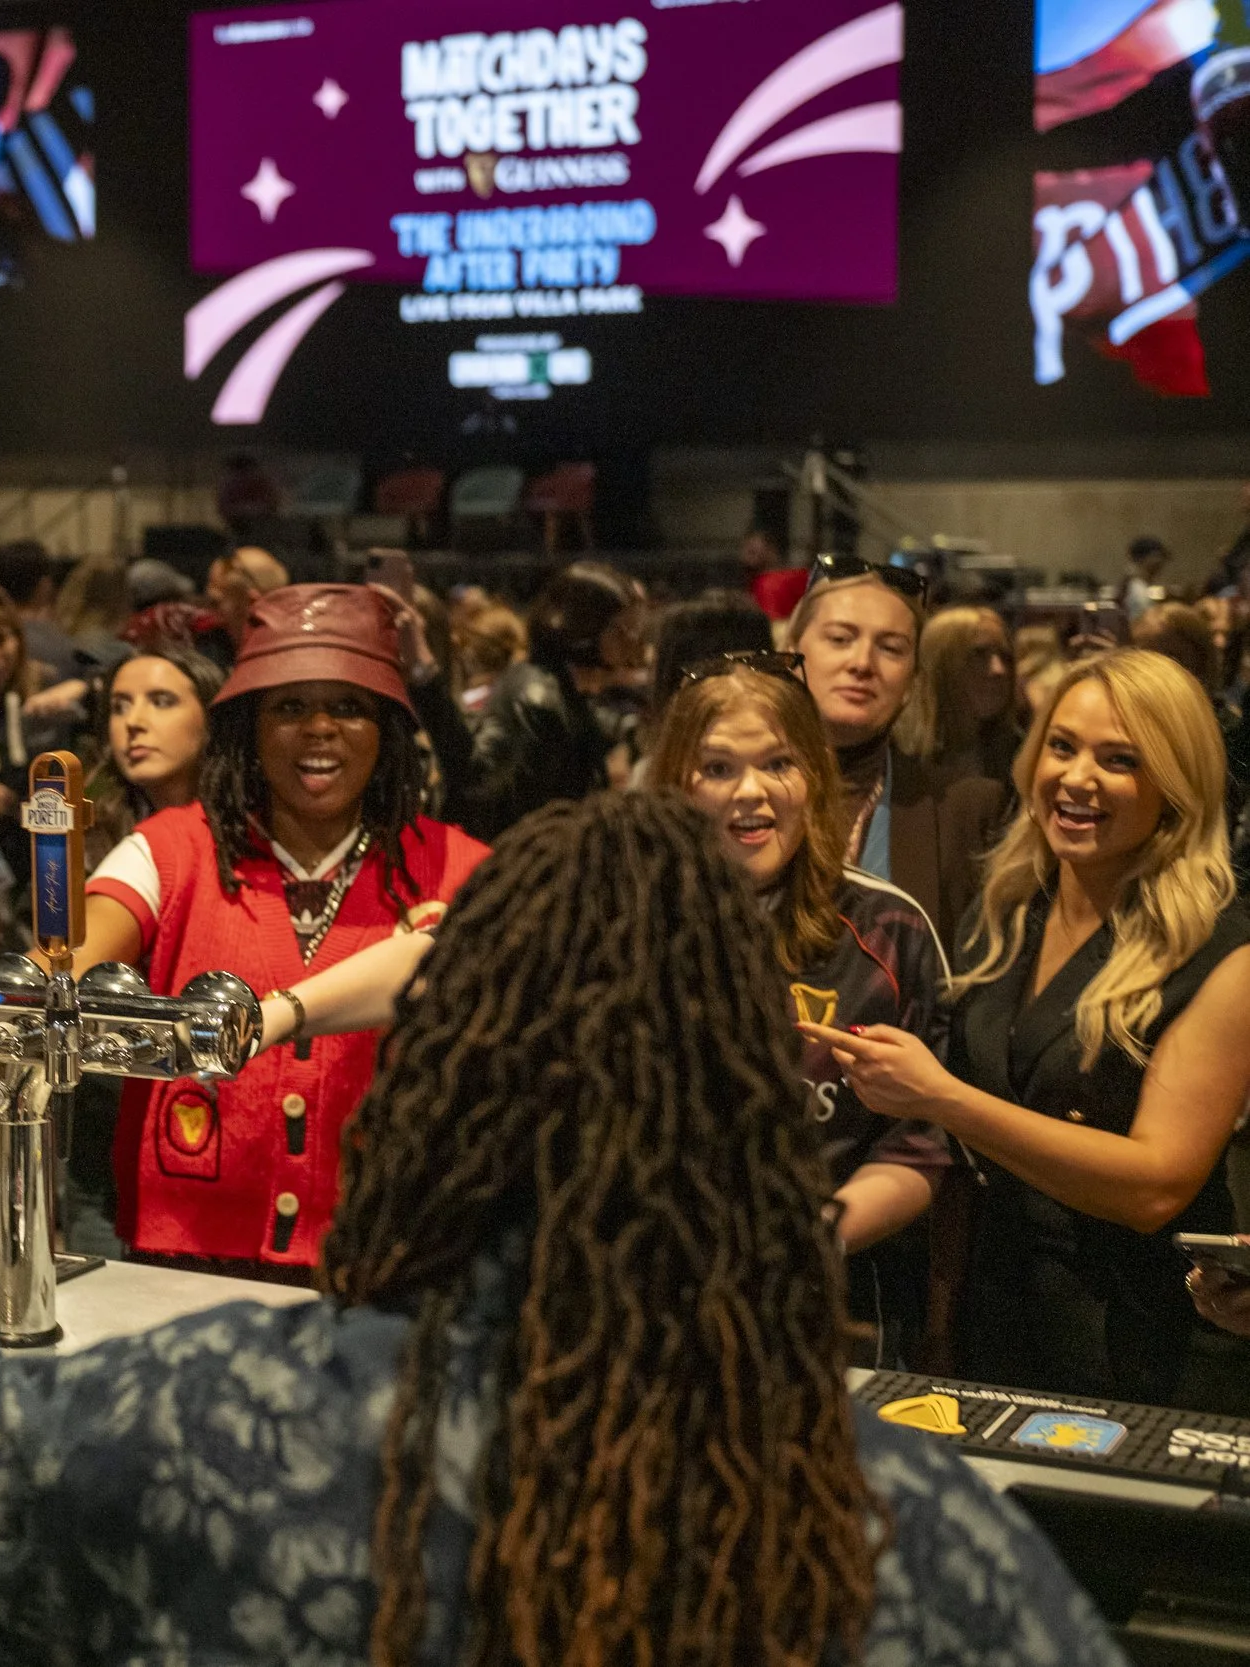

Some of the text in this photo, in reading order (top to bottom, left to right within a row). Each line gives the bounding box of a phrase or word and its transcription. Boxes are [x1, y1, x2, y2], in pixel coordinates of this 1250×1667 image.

[402, 18, 647, 99] MATCHDAYS
[406, 83, 641, 158] TOGETHER
[495, 151, 630, 193] GUINNESS
[28, 809, 68, 826] PORETTI
